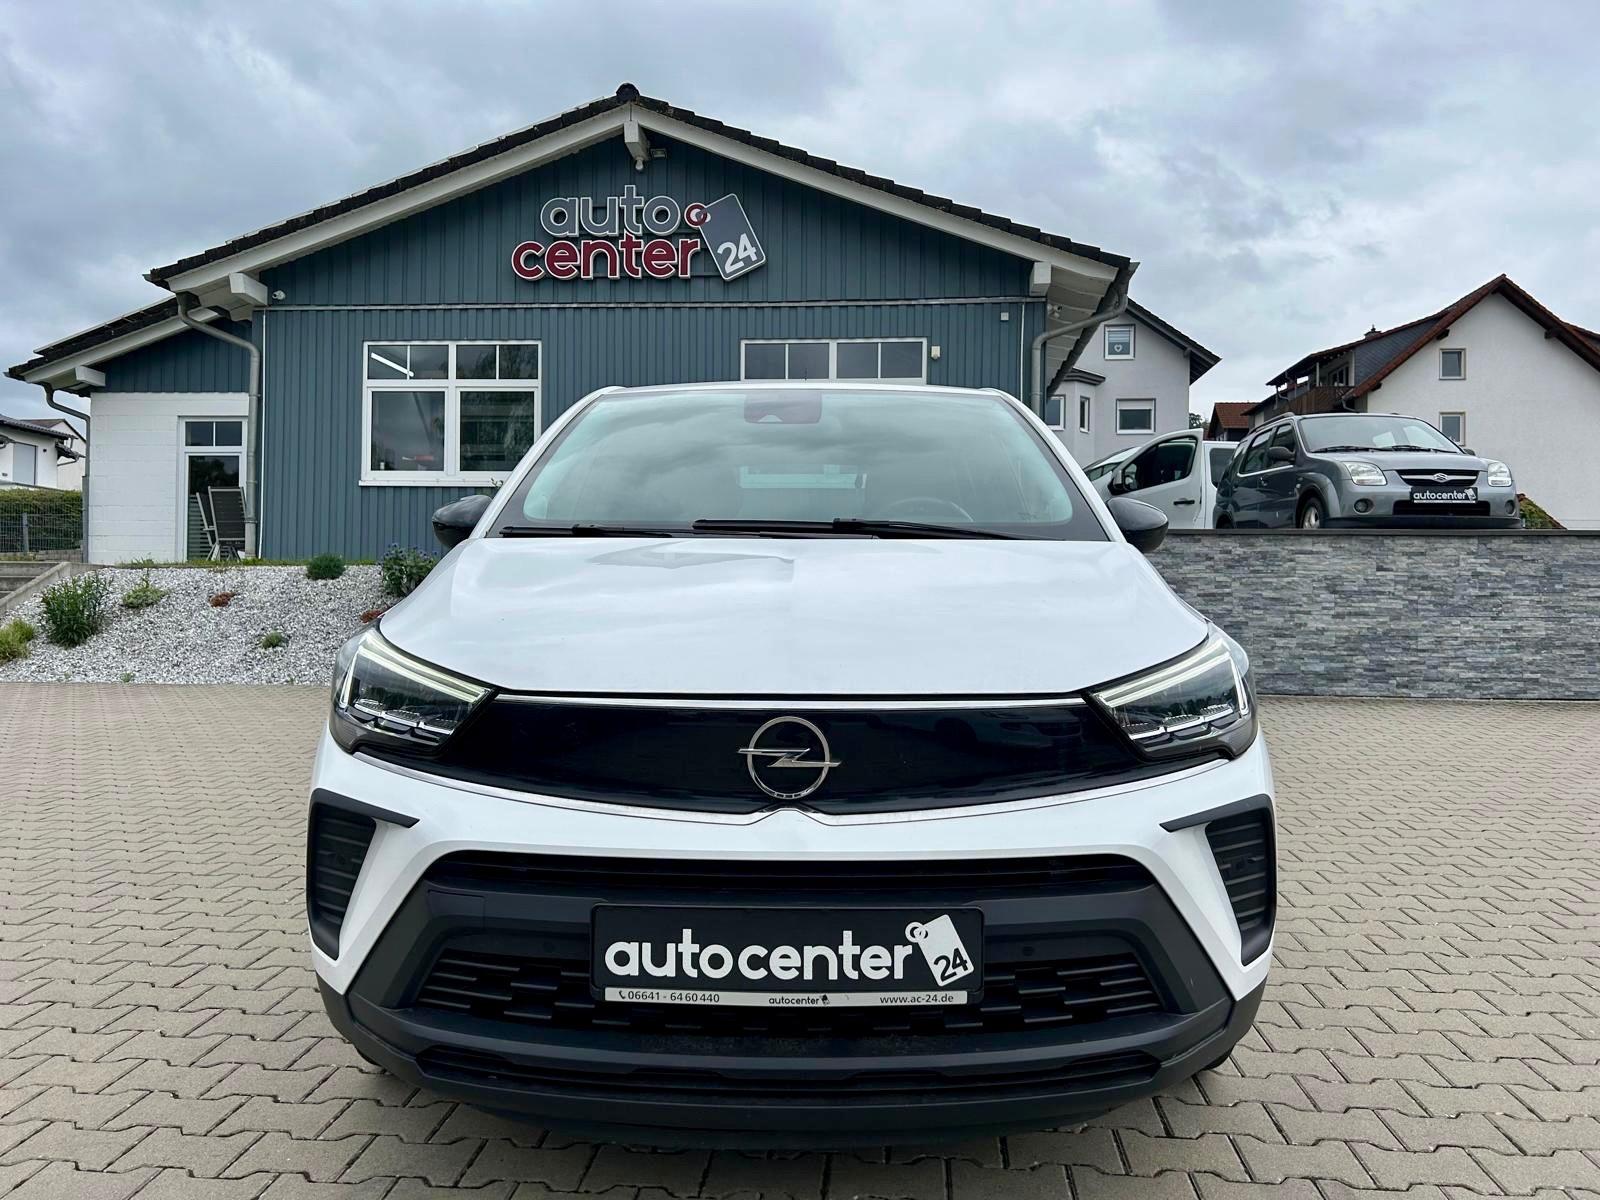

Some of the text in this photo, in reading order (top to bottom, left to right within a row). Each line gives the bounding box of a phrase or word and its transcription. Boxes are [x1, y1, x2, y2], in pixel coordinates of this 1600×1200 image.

[540, 184, 681, 237] auto
[511, 230, 758, 281] center 24
[1413, 490, 1467, 500] autocenter
[604, 928, 969, 983] autocenter 24
[627, 990, 660, 1001] 06641
[768, 994, 820, 1005] autocenter
[879, 993, 954, 1004] www.ac-24.de
